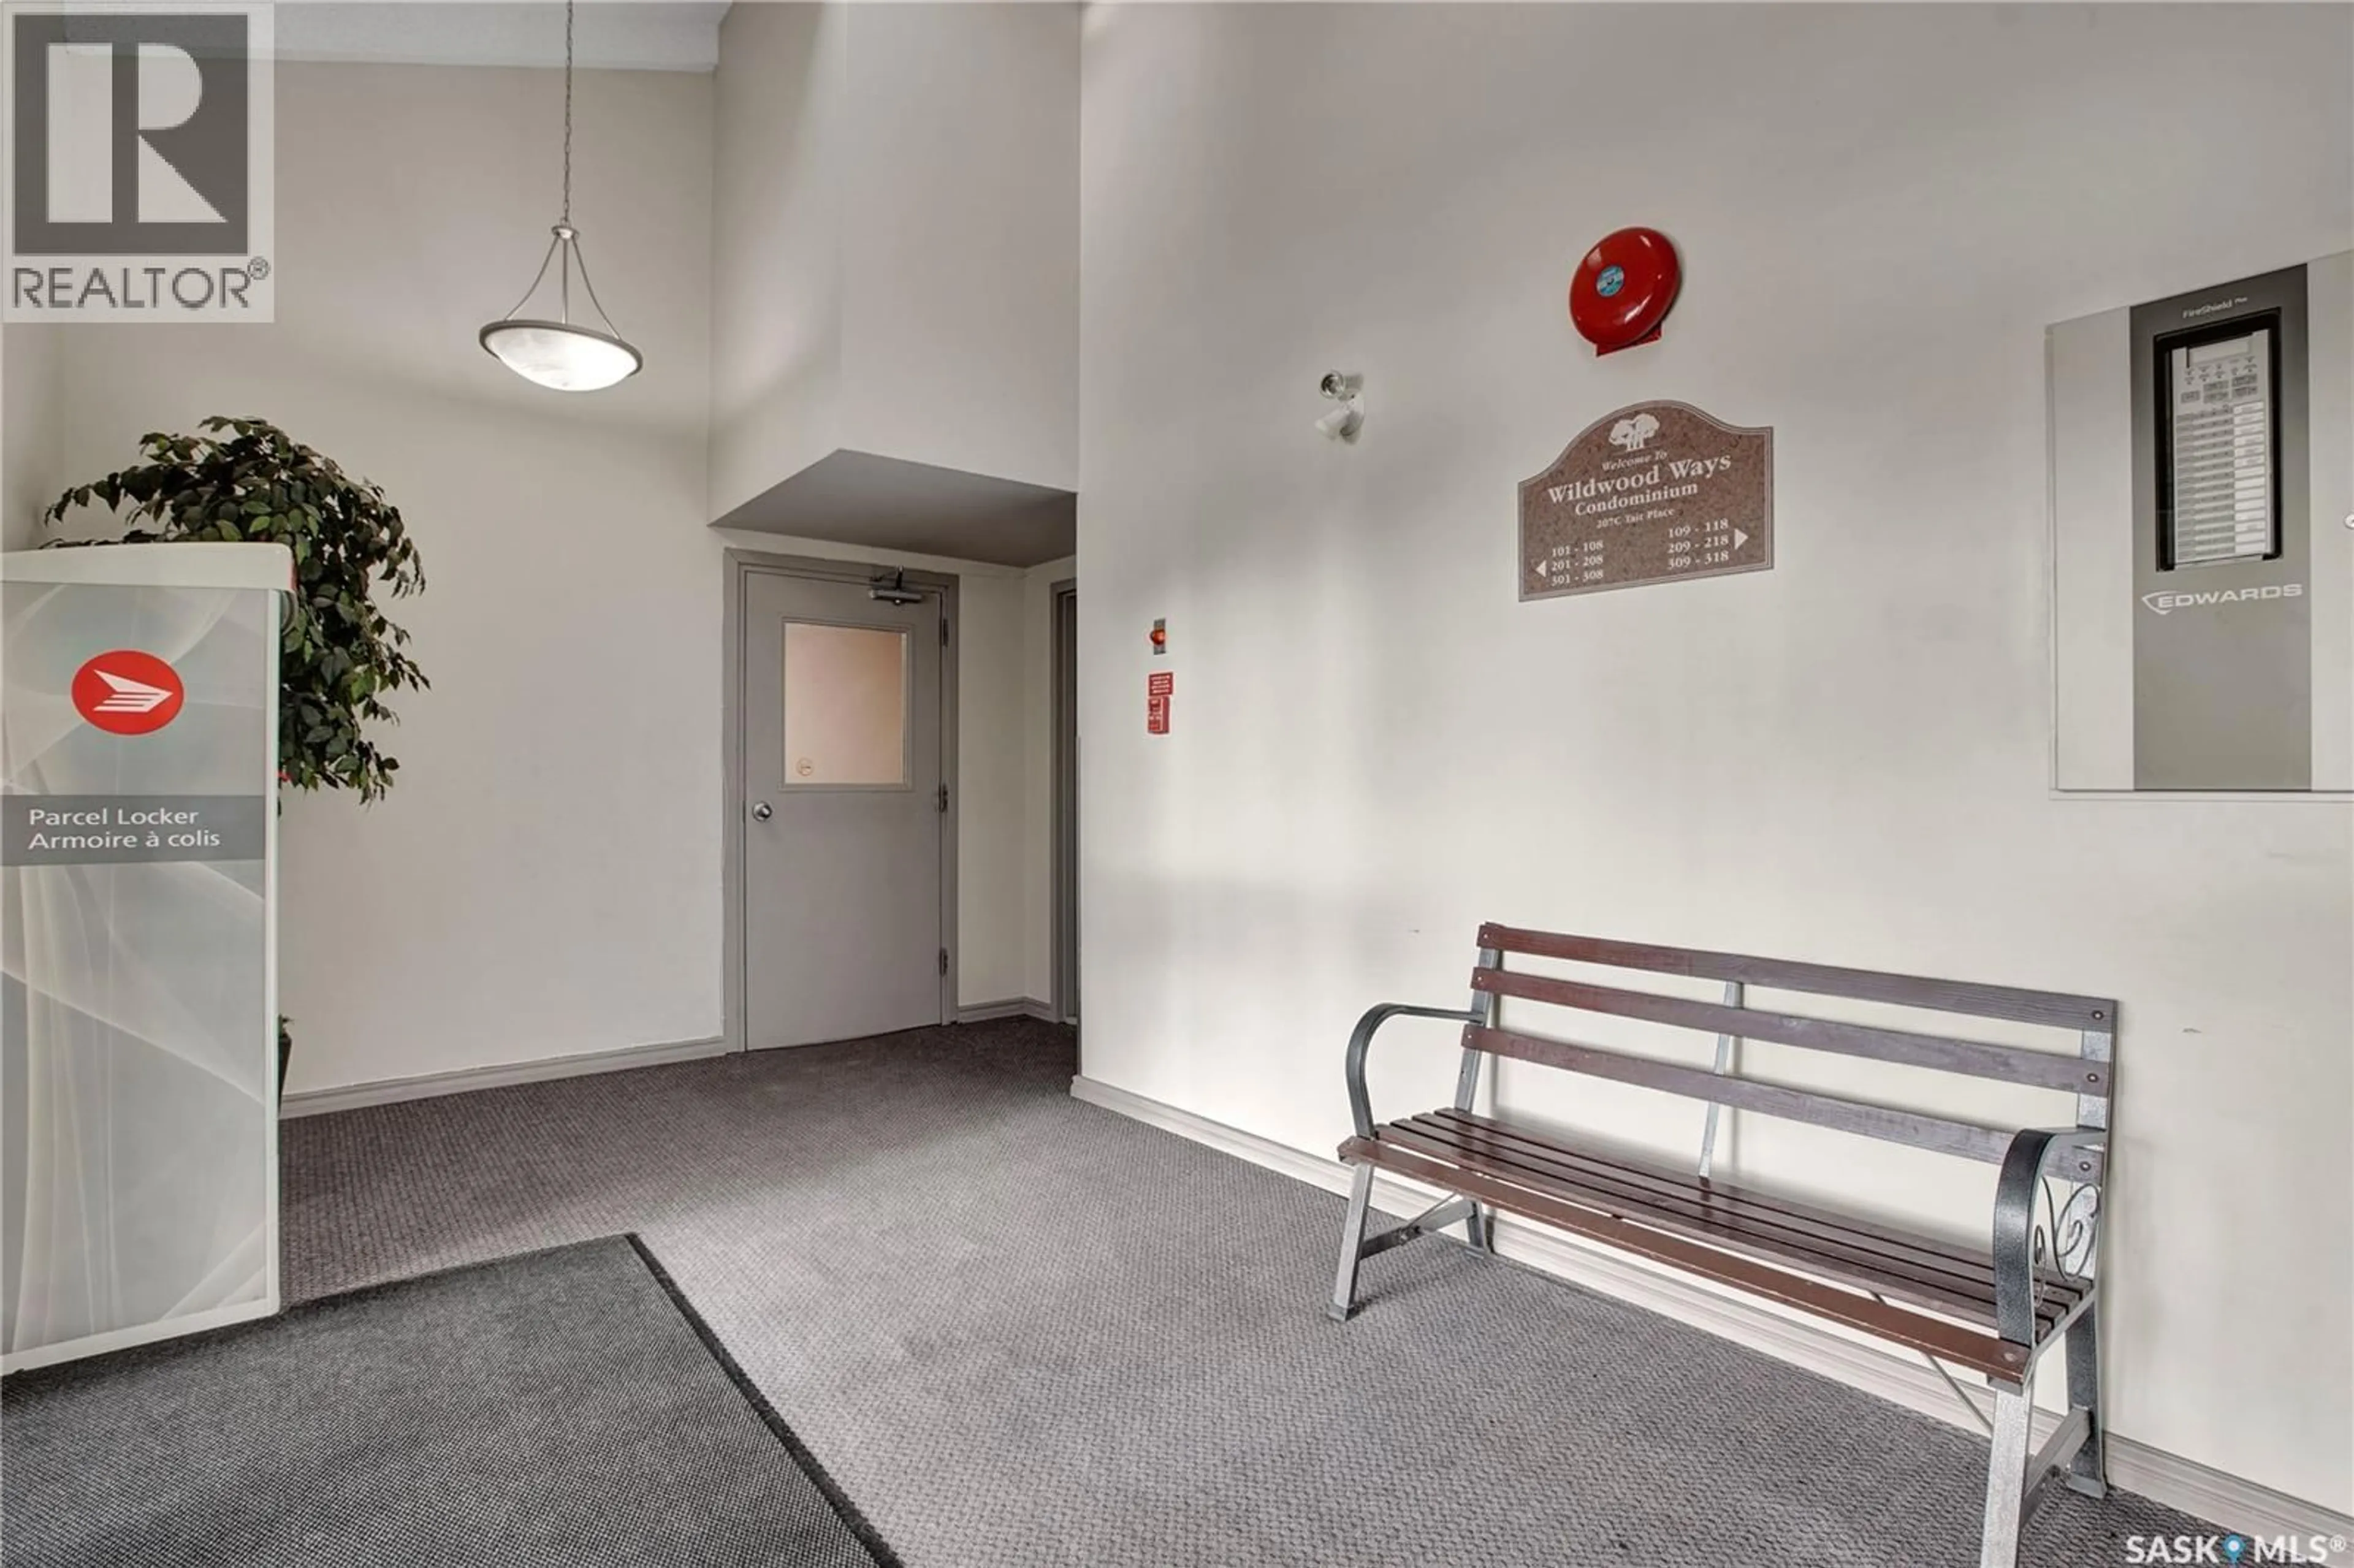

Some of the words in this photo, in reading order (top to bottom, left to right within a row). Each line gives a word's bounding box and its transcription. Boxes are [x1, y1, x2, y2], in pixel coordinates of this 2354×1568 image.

[1601, 455, 1652, 472] Welcome
[1548, 464, 1660, 504] Wildwood
[1668, 454, 1731, 481] Ways
[1575, 483, 1698, 516] Condominium
[1647, 507, 1675, 519] Place
[1668, 525, 1691, 538] 109
[1706, 518, 1729, 532] 118
[1552, 545, 1571, 557] 101
[1583, 540, 1604, 552] 108
[1667, 541, 1691, 554] 209
[1705, 535, 1729, 549] 218
[1552, 559, 1571, 572] 201
[1583, 554, 1604, 566] 208
[1667, 556, 1691, 570] 309
[1705, 549, 1729, 565] 318
[1551, 573, 1571, 587] 301
[1582, 568, 1604, 582] 308
[2158, 584, 2303, 608] EDWARDS
[29, 808, 107, 826] Parcel
[118, 807, 199, 825] Locker
[28, 831, 138, 850] Armoire
[145, 831, 160, 847] à
[168, 829, 221, 847] colis
